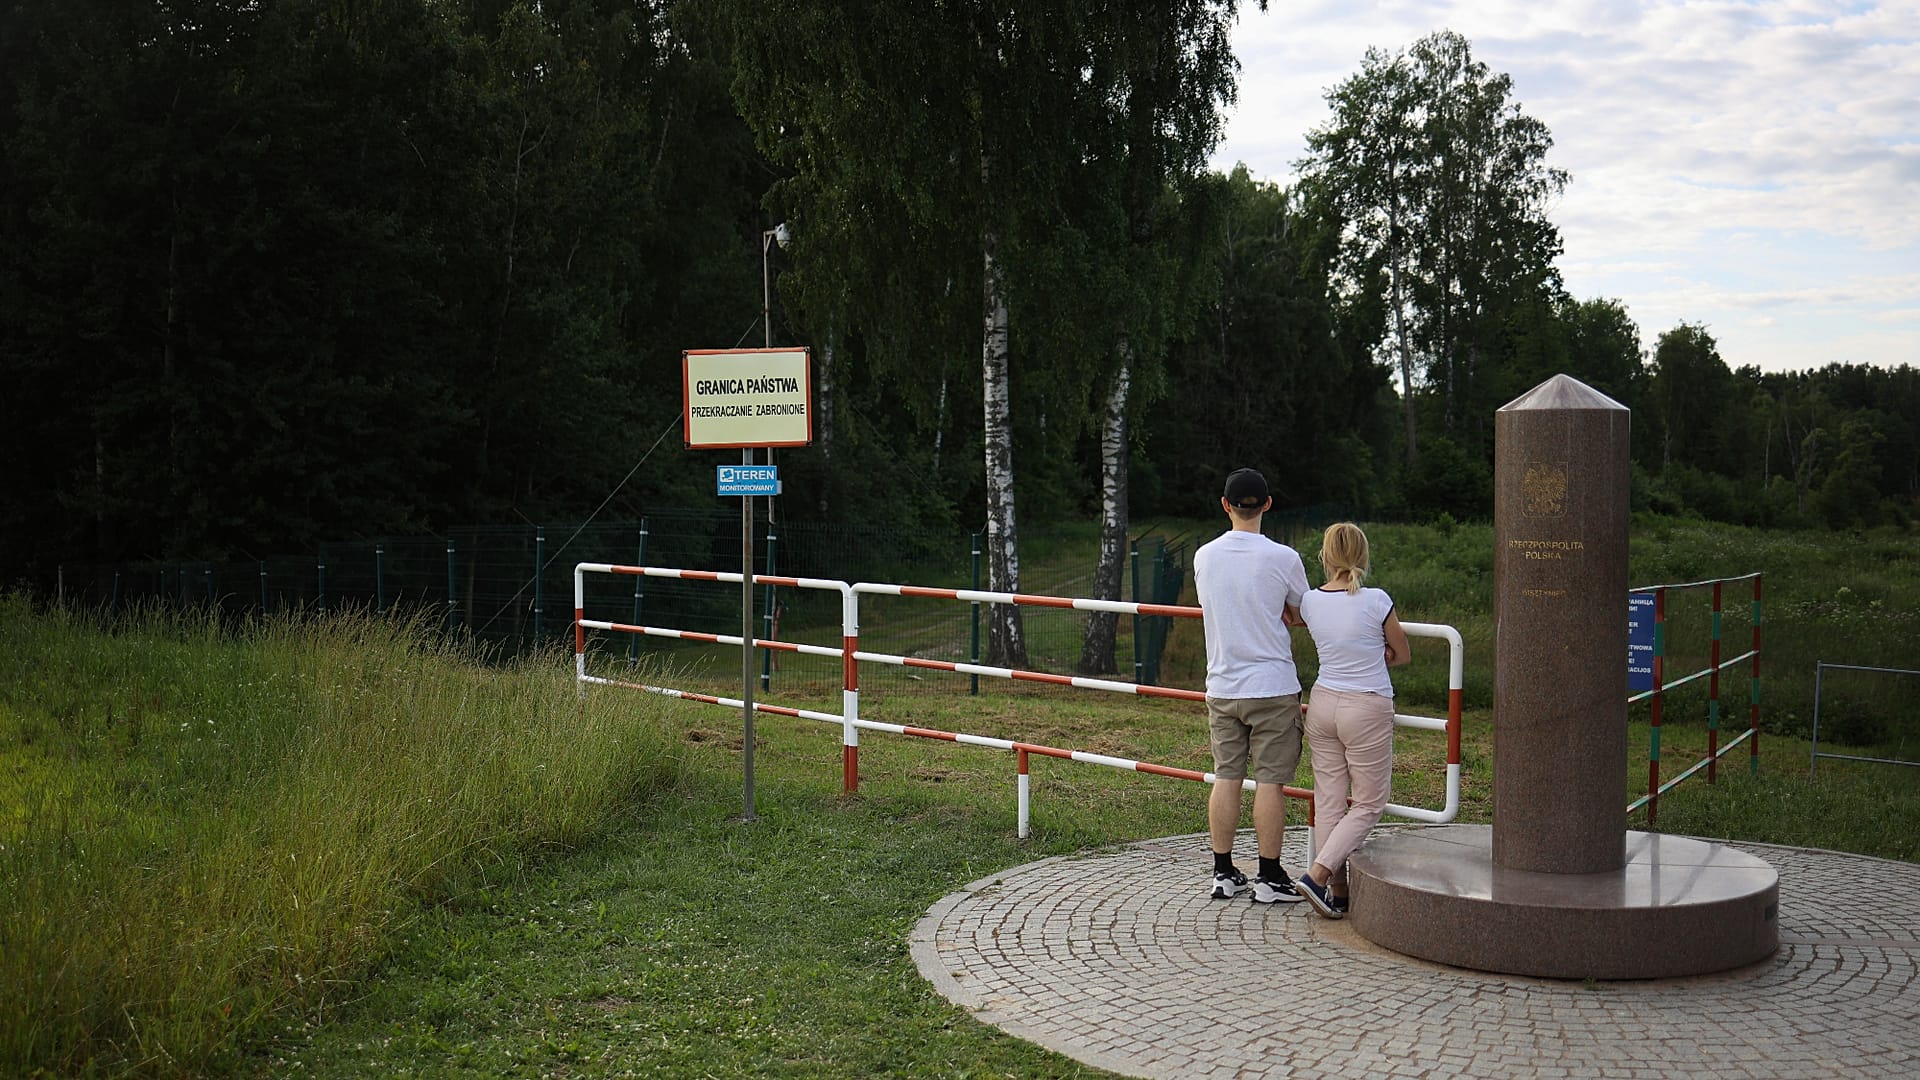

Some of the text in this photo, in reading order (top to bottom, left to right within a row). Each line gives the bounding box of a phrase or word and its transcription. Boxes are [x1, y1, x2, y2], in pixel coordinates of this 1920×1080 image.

[696, 375, 799, 395] GRANICA PAŃSTWA
[691, 403, 805, 418] PRZEKRACZANIE ZABRONIONE
[734, 469, 775, 480] TEREN
[719, 483, 774, 492] MONITOROWANY
[1508, 540, 1584, 550] RZECZPOSPOLITA
[1525, 551, 1561, 560] POLSKA
